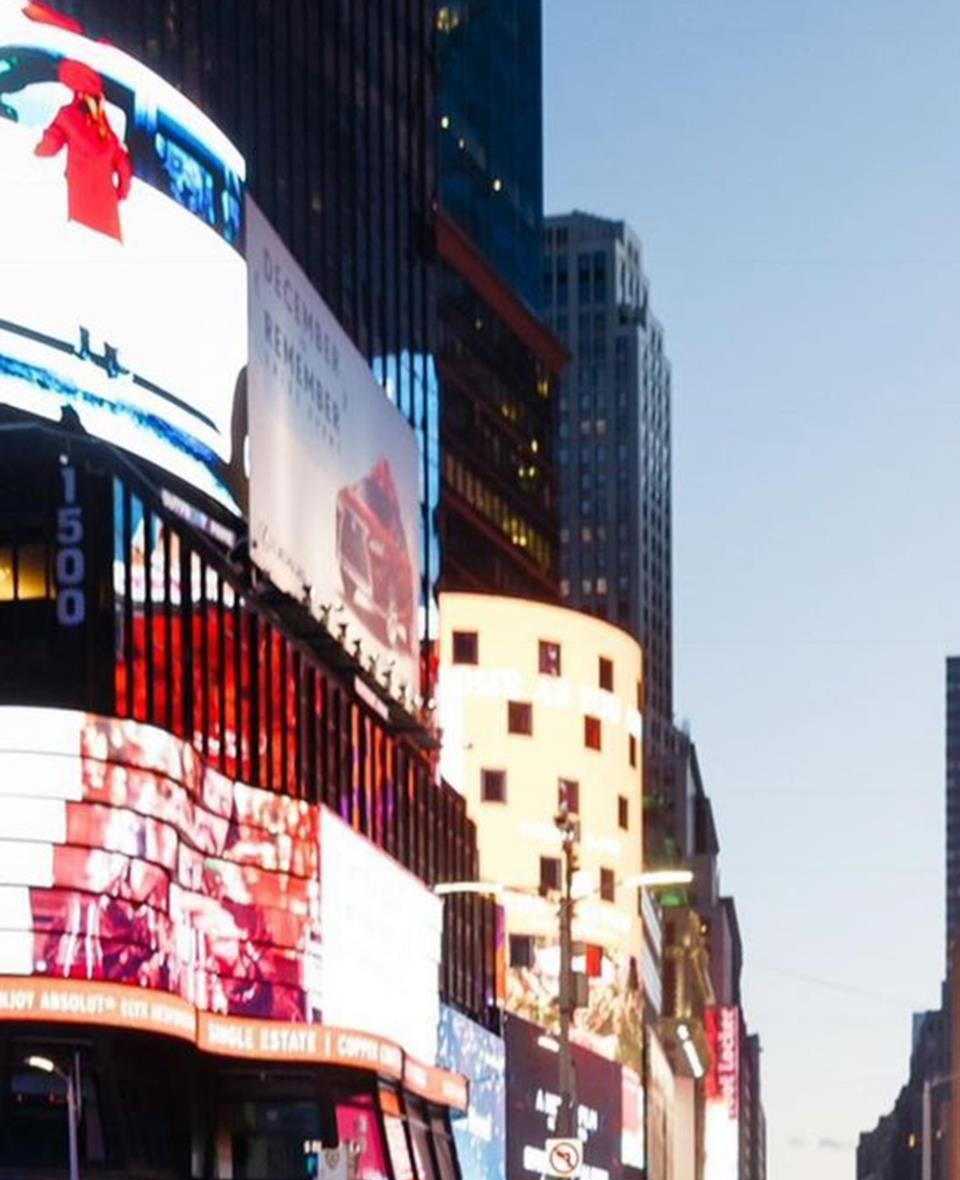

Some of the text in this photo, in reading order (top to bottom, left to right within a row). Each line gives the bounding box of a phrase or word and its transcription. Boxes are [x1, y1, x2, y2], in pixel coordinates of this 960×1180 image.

[263, 247, 341, 376] DECEMBER
[263, 311, 341, 432] REMEMBER
[56, 465, 86, 628] 1500
[259, 1026, 317, 1055] ESTATE
